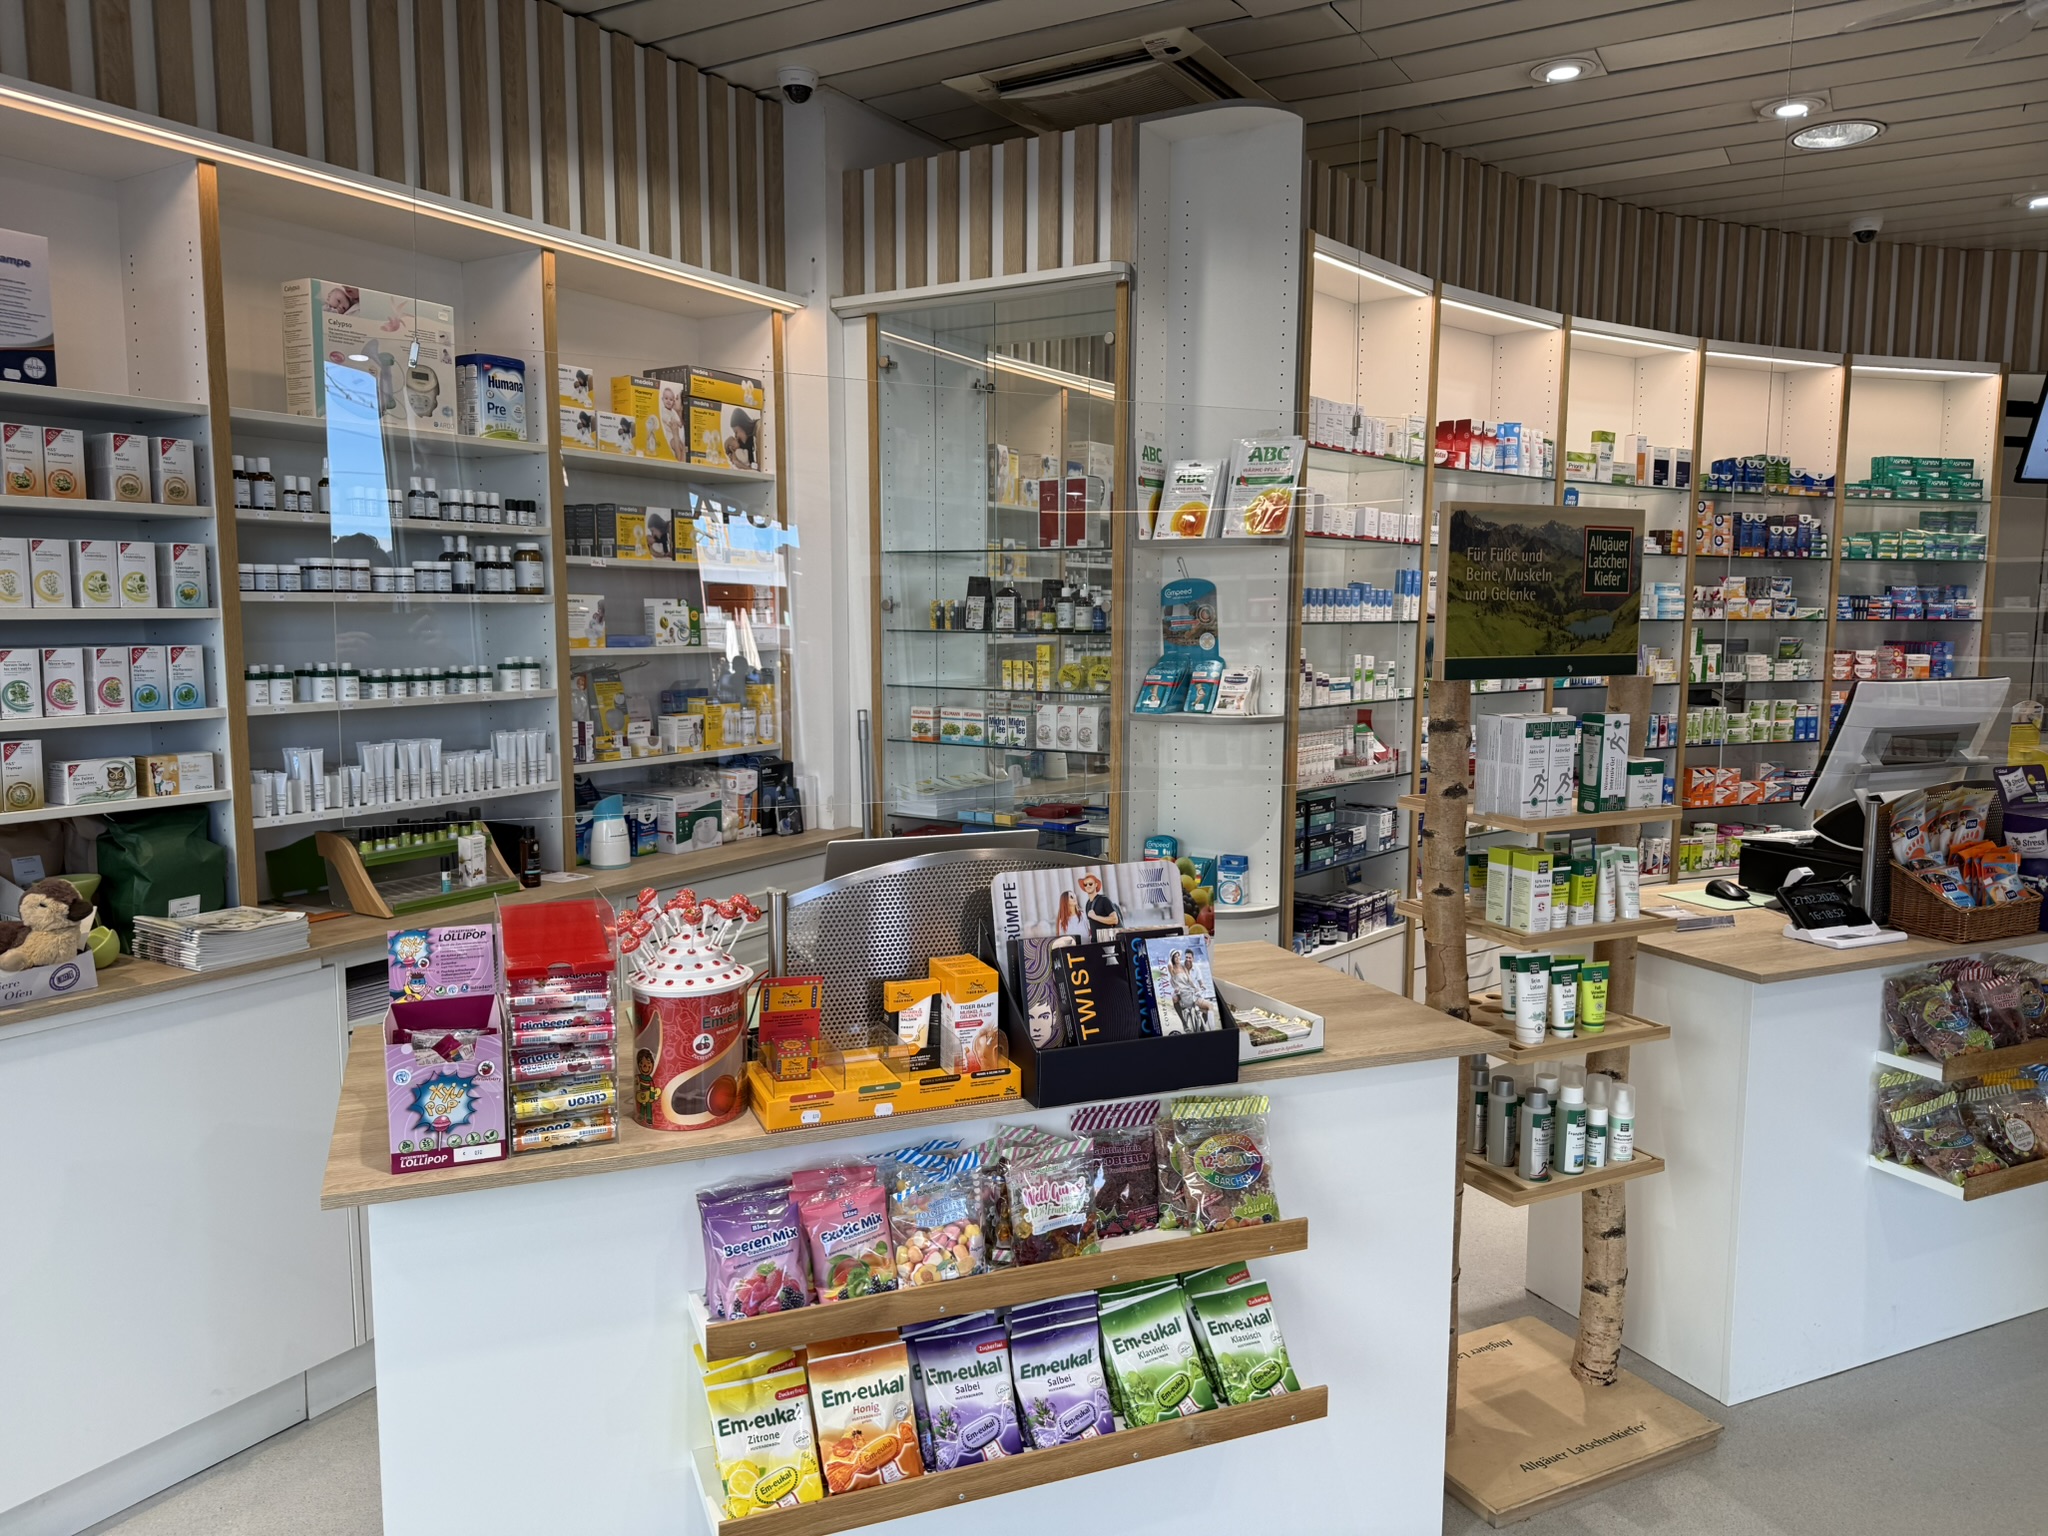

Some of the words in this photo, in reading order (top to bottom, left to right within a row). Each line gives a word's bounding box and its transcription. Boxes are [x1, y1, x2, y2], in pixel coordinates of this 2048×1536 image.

[328, 318, 352, 329] Calypso
[692, 368, 709, 376] medela
[488, 375, 523, 393] Humana
[634, 378, 654, 387] medela
[487, 402, 506, 416] Pre
[439, 421, 455, 430] ARDO
[1142, 445, 1162, 463] ABC
[1248, 446, 1290, 462] ABC
[1176, 474, 1205, 484] ABC
[1589, 535, 1629, 554] Allgäuer
[1466, 547, 1487, 561] Für
[1490, 547, 1518, 562] Füße
[1521, 549, 1543, 563] und
[1588, 554, 1628, 569] Latschen
[1466, 567, 1501, 583] Beine,
[1505, 567, 1552, 582] Muskeln
[1594, 570, 1621, 587] Kiefer
[1164, 588, 1193, 598] Compeed
[1465, 587, 1487, 601] und
[1491, 587, 1537, 601] Gelenke
[1149, 668, 1176, 676] Compeed
[988, 716, 1006, 726] Midro
[1008, 717, 1026, 727] Midro
[1527, 722, 1551, 733] MOBIL
[995, 726, 1006, 734] Tee
[1015, 727, 1026, 735] Tee
[1146, 840, 1170, 848] Compeed
[2022, 839, 2045, 847] Stress
[1793, 891, 1840, 906] 27.02.2026
[1808, 907, 1847, 921] 16:18:52
[438, 930, 487, 942] LOLLIPOP
[4, 990, 33, 1001] Ofen
[1067, 953, 1101, 1041] TWIST
[709, 1001, 740, 1015] Kinder
[520, 1018, 574, 1031] Himbeere
[567, 1092, 608, 1108] citron
[424, 1099, 456, 1117] POP
[400, 1155, 448, 1168] LOLLIPOP
[1215, 1171, 1253, 1186] BÄRCHEN
[1243, 1199, 1274, 1215] sauer!
[751, 1222, 769, 1232] Bloc
[820, 1222, 860, 1244] Exotic
[860, 1213, 884, 1231] Mix
[723, 1233, 771, 1257] Beeren
[772, 1226, 798, 1244] Mix
[1247, 1294, 1271, 1307] Zuckerfrei
[1206, 1307, 1272, 1337] Em-eukal
[1112, 1316, 1182, 1355] Em-eukal
[1229, 1329, 1262, 1344] Klassisch
[978, 1340, 1004, 1353] Zuckerfrei
[1136, 1342, 1171, 1360] Klassisch
[1470, 1338, 1513, 1355] Allgäuer
[926, 1356, 1003, 1386] Em-eukal
[1019, 1348, 1094, 1380] Em-eukal
[954, 1381, 981, 1394] Salbei
[1047, 1374, 1073, 1387] Salbei
[777, 1387, 806, 1400] Zuckerfrei
[821, 1377, 906, 1408] Em-eukal
[852, 1402, 880, 1415] Honig
[747, 1430, 781, 1445] Zitrone
[1518, 1451, 1569, 1473] Allgäuer
[1566, 1421, 1648, 1456] Latschenkiefer
